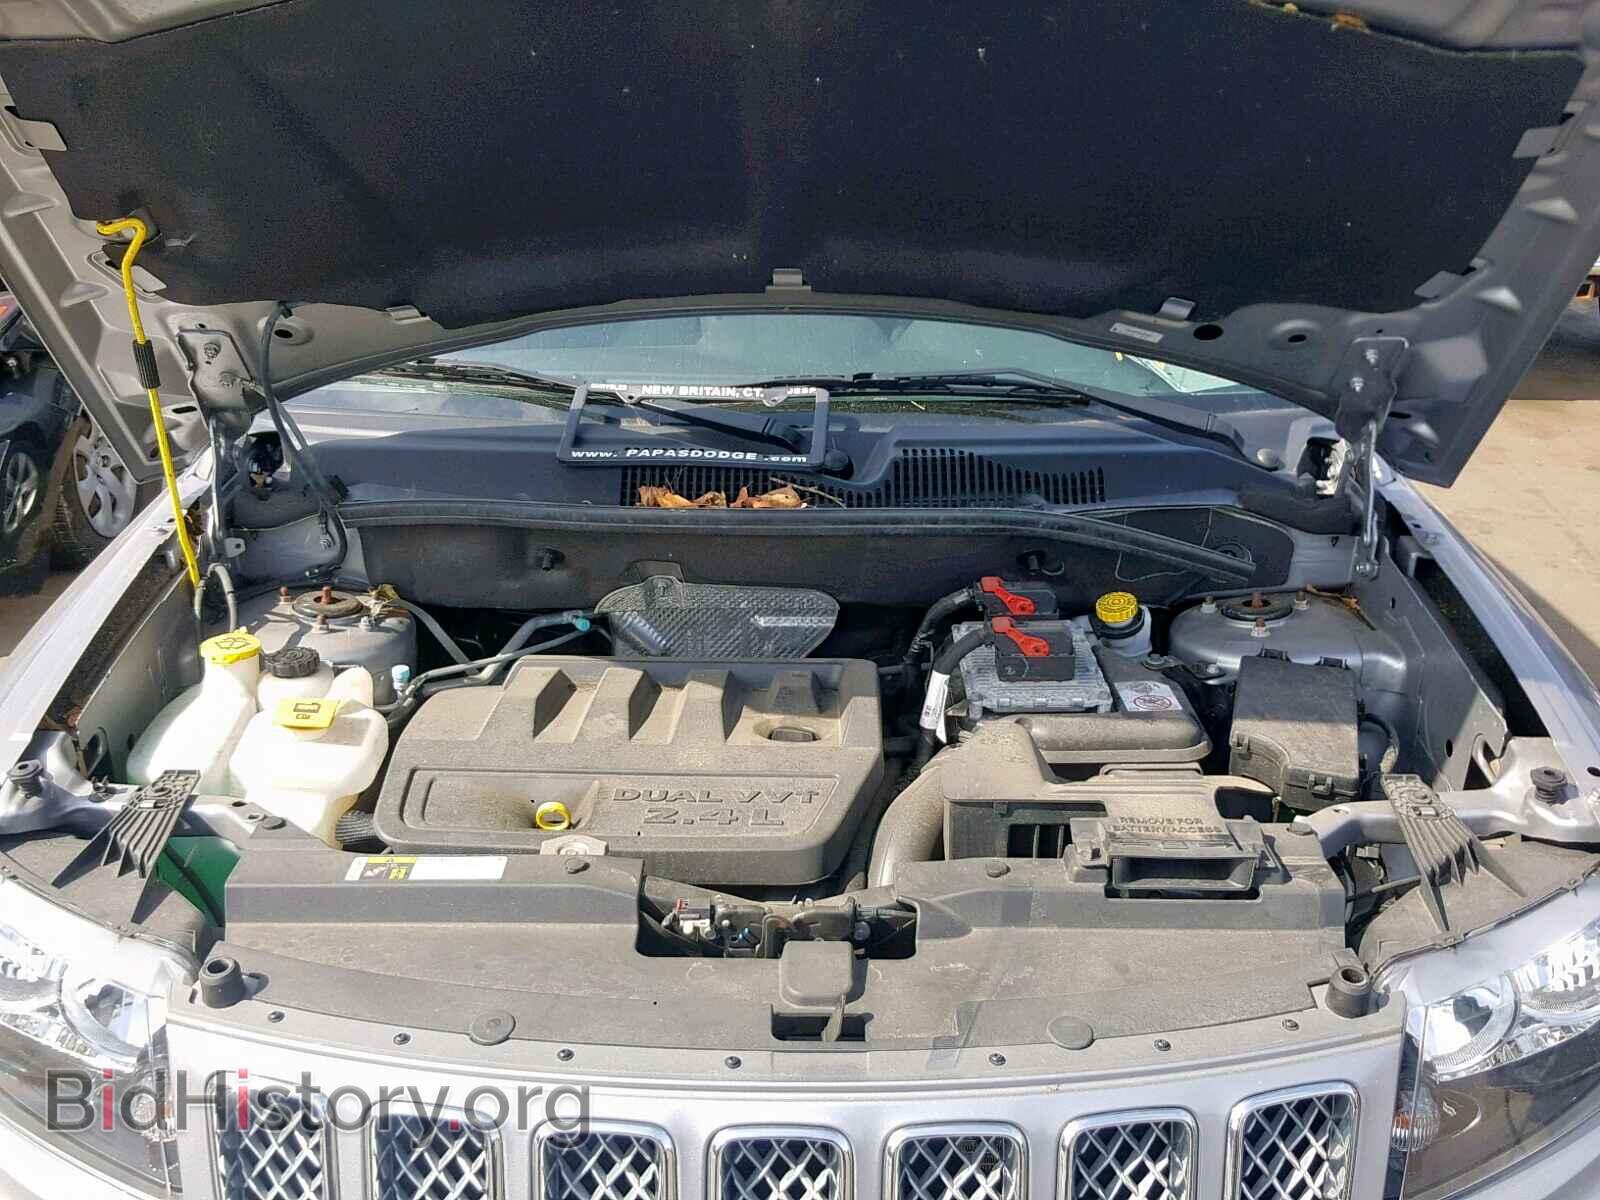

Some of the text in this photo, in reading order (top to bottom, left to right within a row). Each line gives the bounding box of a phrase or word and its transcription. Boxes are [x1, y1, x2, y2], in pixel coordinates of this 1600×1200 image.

[641, 385, 764, 398] NEW BRITAIN, CT.
[571, 448, 807, 463] www. PAPASDODGE .com
[612, 788, 820, 804] DUAL VVT
[1119, 816, 1204, 825] REMOVE FOR
